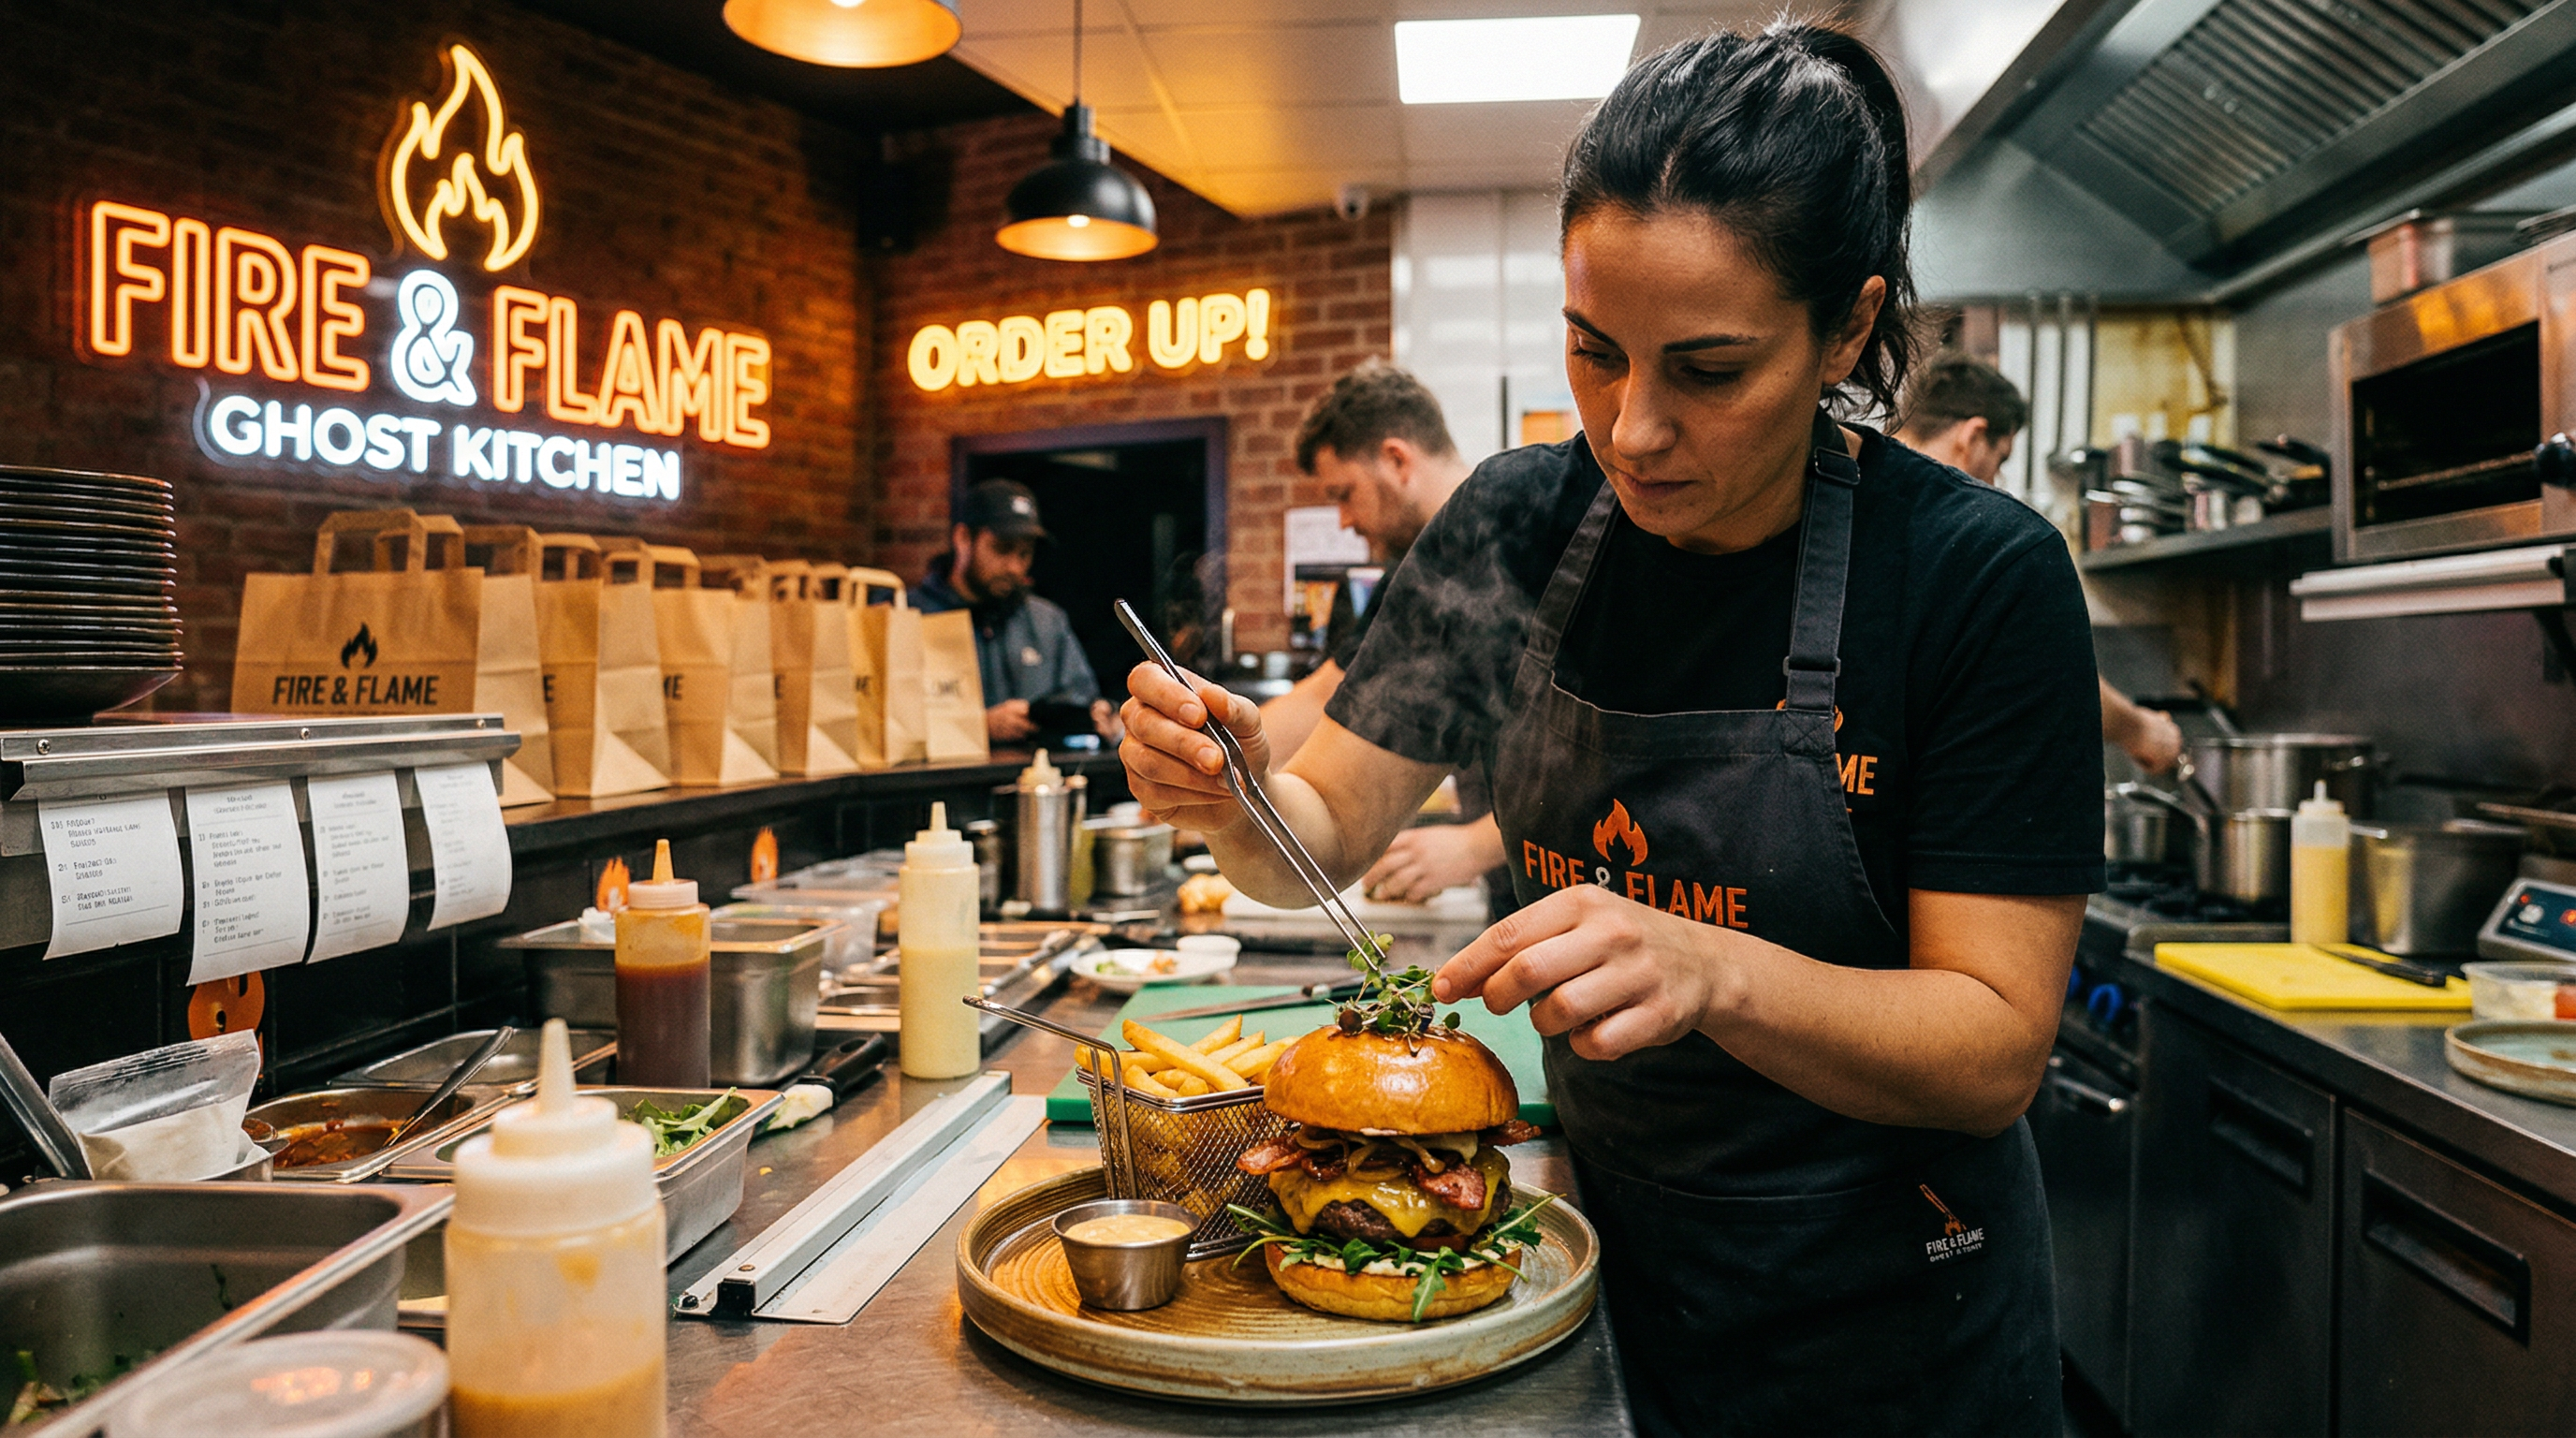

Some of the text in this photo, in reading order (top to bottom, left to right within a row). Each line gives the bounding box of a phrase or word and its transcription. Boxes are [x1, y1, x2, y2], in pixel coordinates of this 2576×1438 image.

[91, 200, 770, 448] FIRE & FLAME
[907, 288, 1271, 391] ORDER UP!
[210, 396, 681, 501] GHOST KITCHEN
[272, 675, 439, 705] FIRE & FLAME
[1625, 871, 1749, 929] FLAME
[1925, 1238, 1950, 1255] FIRE
